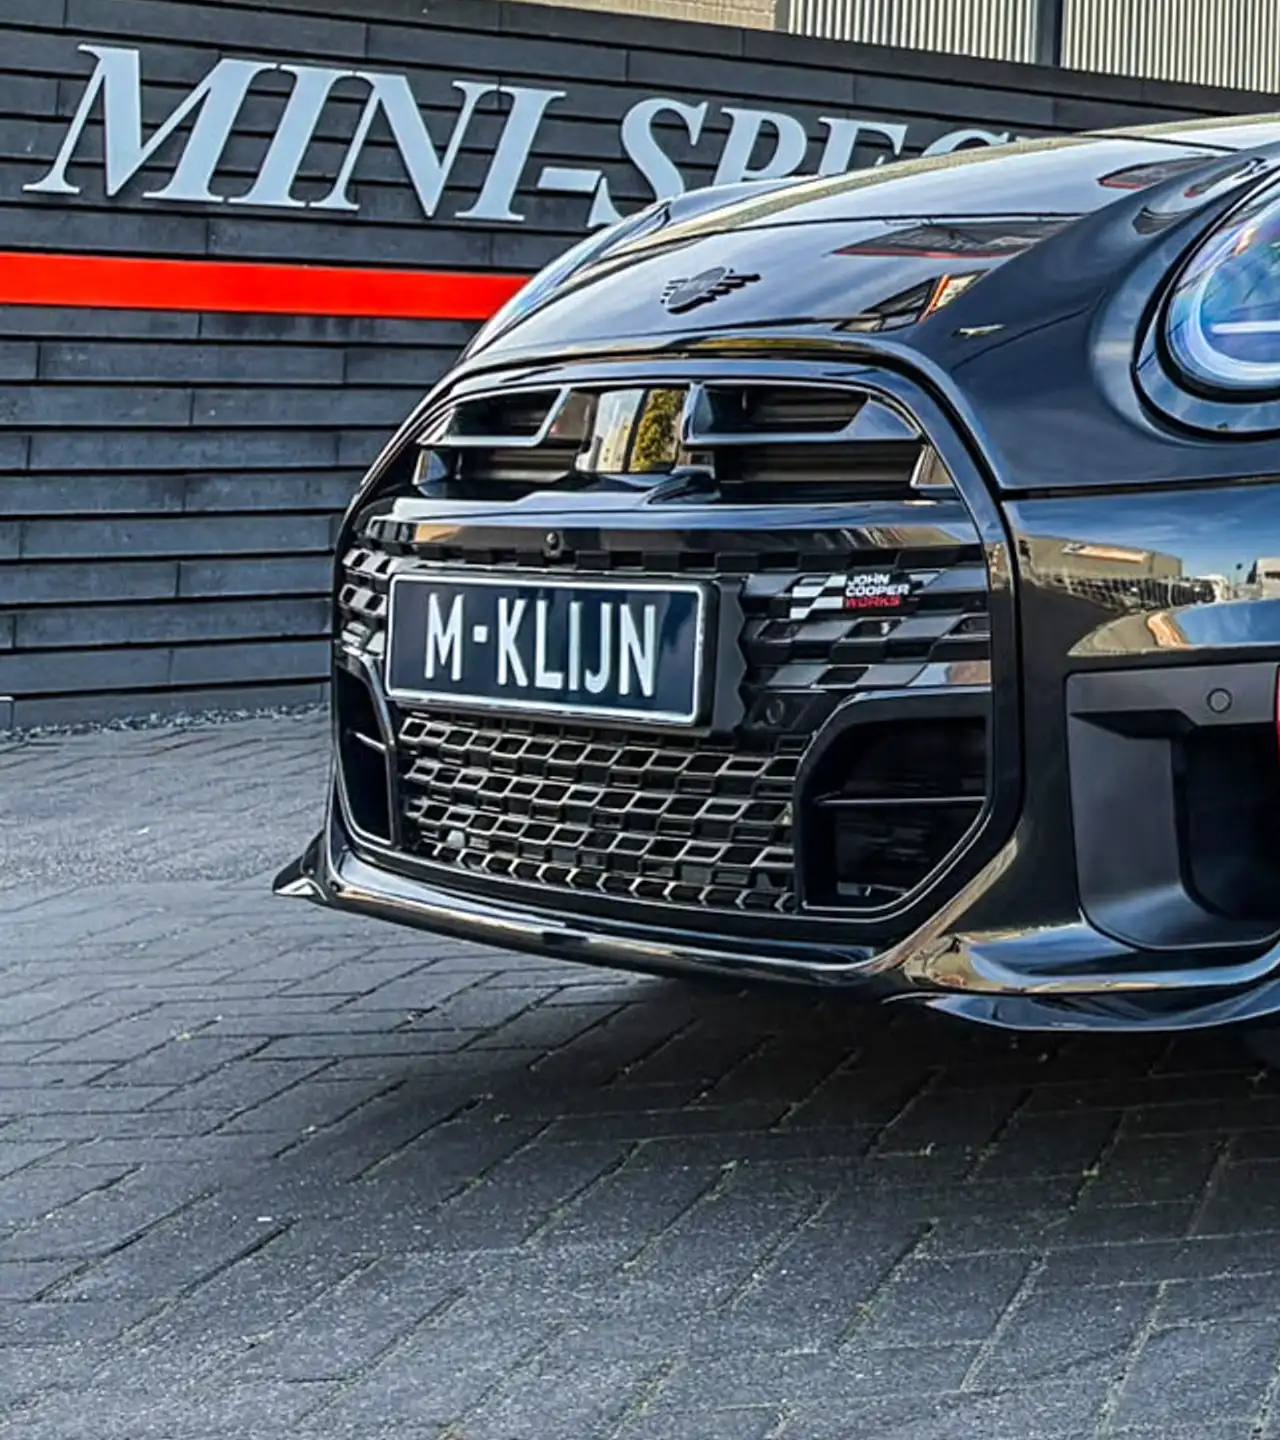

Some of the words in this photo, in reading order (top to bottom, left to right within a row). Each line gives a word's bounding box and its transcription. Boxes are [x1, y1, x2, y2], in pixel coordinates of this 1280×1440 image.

[22, 44, 1010, 229] MINI-SP
[846, 583, 910, 597] COOPER
[848, 572, 890, 586] JOHN
[424, 592, 656, 698] M-KLIJN
